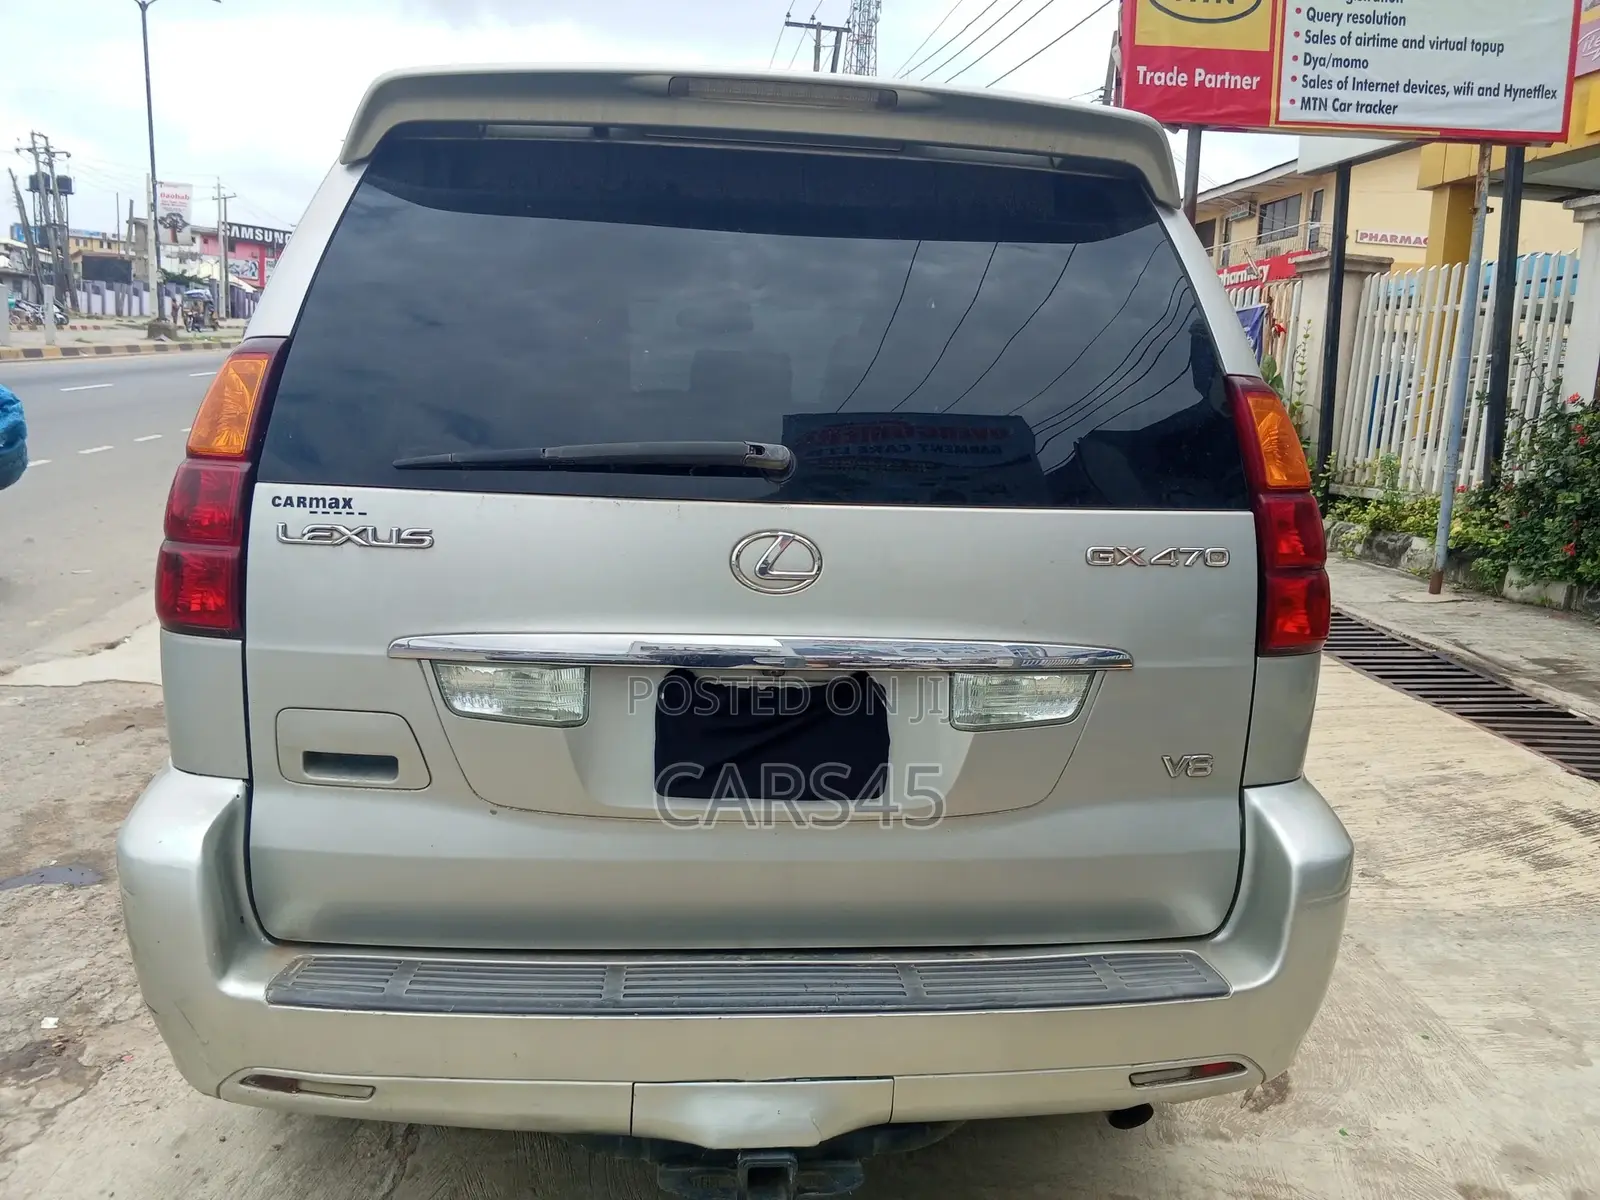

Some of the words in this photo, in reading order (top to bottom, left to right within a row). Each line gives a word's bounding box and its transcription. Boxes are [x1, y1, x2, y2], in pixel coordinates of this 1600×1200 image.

[1306, 7, 1344, 27] Query
[1346, 9, 1406, 26] resolution
[1304, 29, 1337, 46] Sales
[1340, 30, 1352, 46] of
[1355, 32, 1398, 49] airtime
[1402, 34, 1426, 50] and
[1429, 36, 1468, 51] virtual
[1470, 38, 1505, 57] topup
[1303, 52, 1370, 70] Dya/momo
[1136, 65, 1189, 87] Trade
[1194, 68, 1261, 90] Partner
[1301, 74, 1333, 90] Sales
[1337, 76, 1349, 91] of
[1351, 76, 1400, 93] Internet
[1403, 79, 1450, 97] devices,
[1453, 81, 1474, 97] wifi
[1477, 83, 1501, 97] and
[1300, 96, 1328, 111] MTN
[1332, 98, 1353, 112] Car
[1355, 100, 1398, 115] tracker
[276, 521, 435, 549] LEXUS
[1162, 753, 1214, 779] V8
